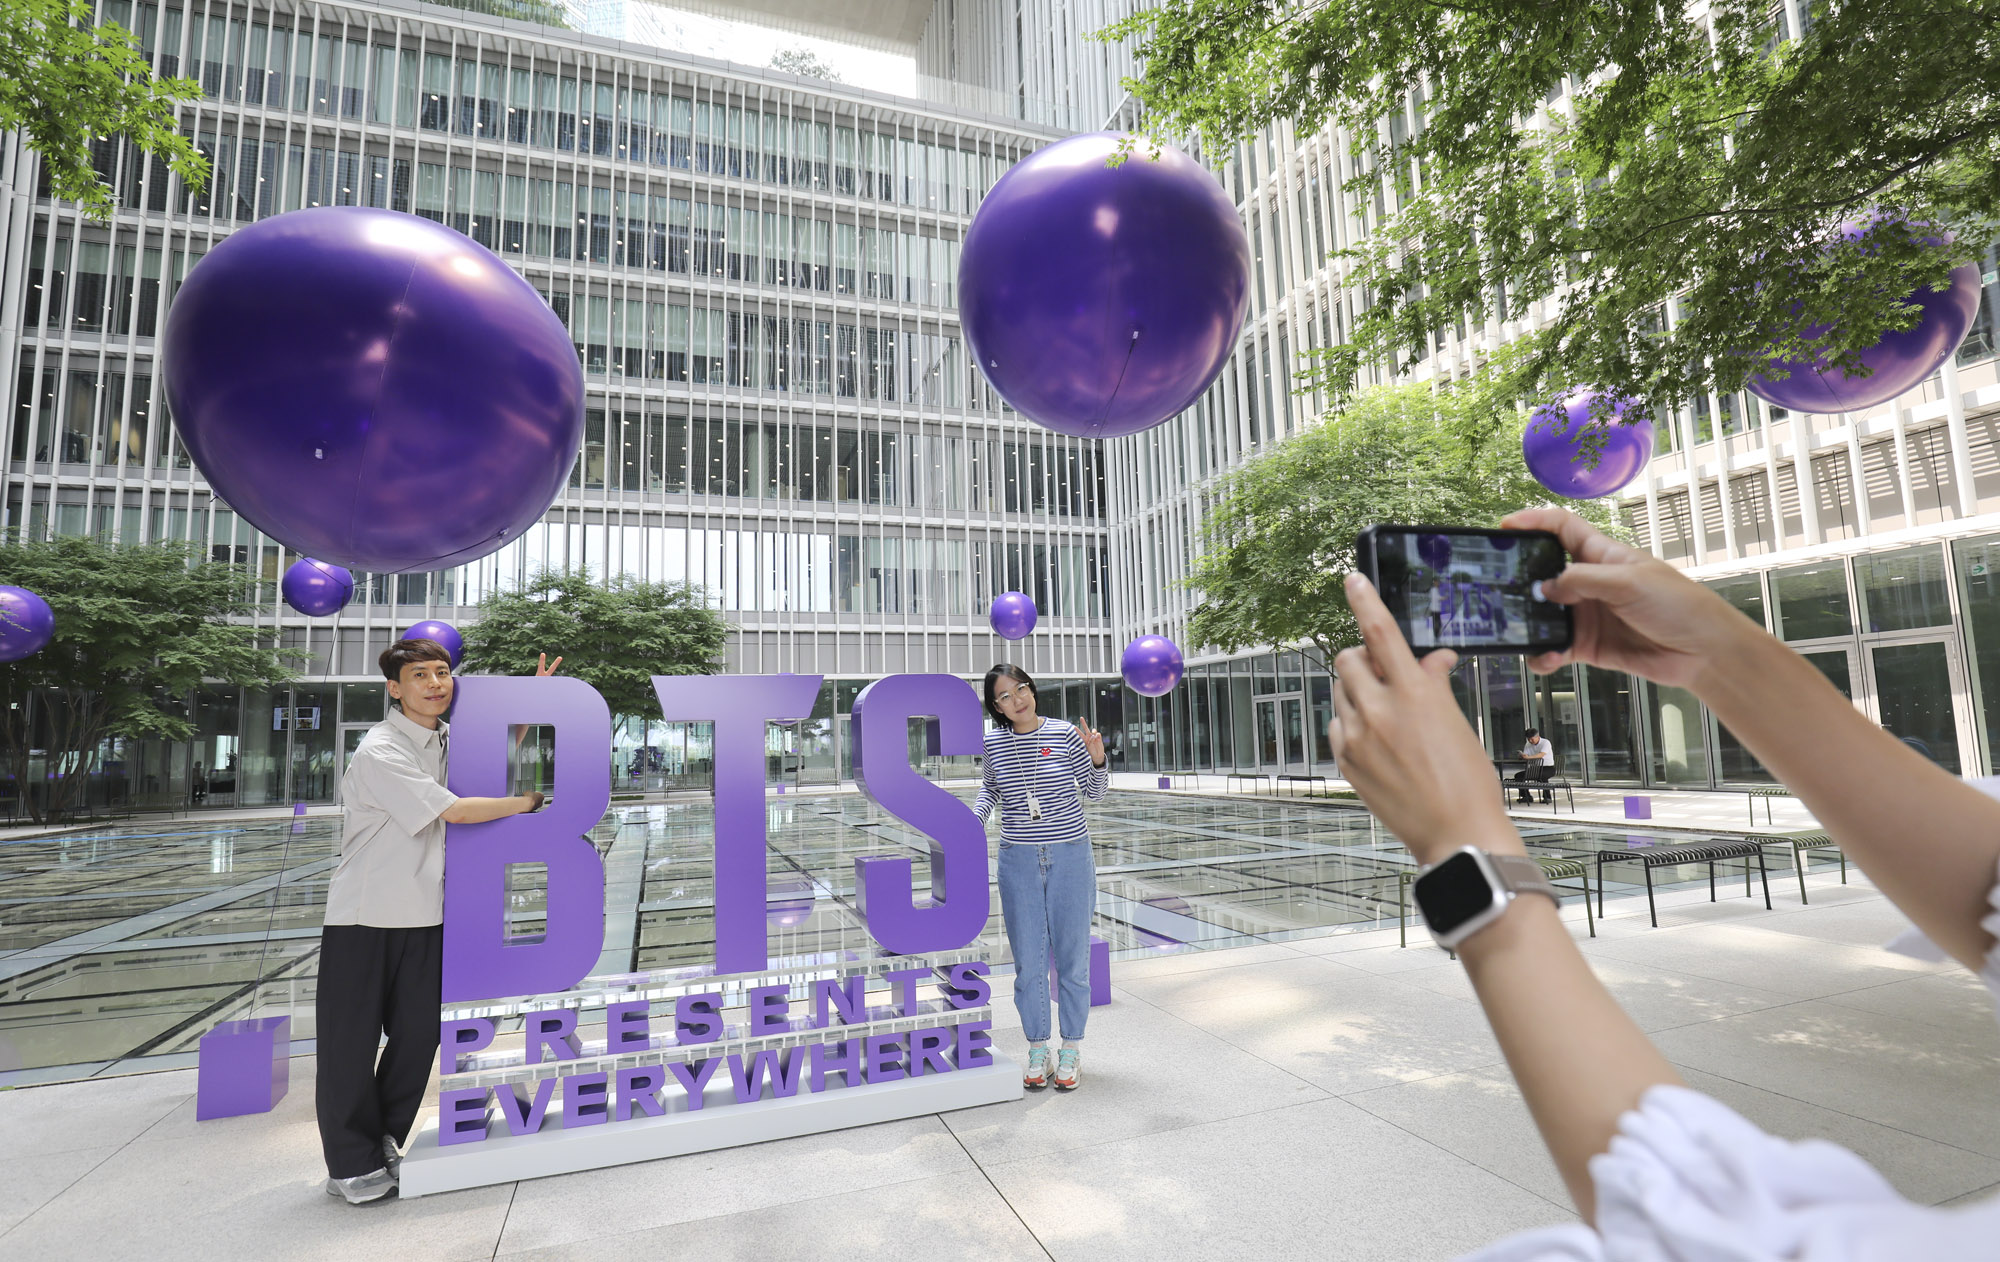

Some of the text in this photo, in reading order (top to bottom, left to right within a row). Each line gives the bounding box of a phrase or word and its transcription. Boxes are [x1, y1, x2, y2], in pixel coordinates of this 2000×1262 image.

[441, 673, 990, 1003] BTS
[440, 961, 991, 1076] PRESENTS
[438, 1020, 993, 1146] EVERYWHERE
